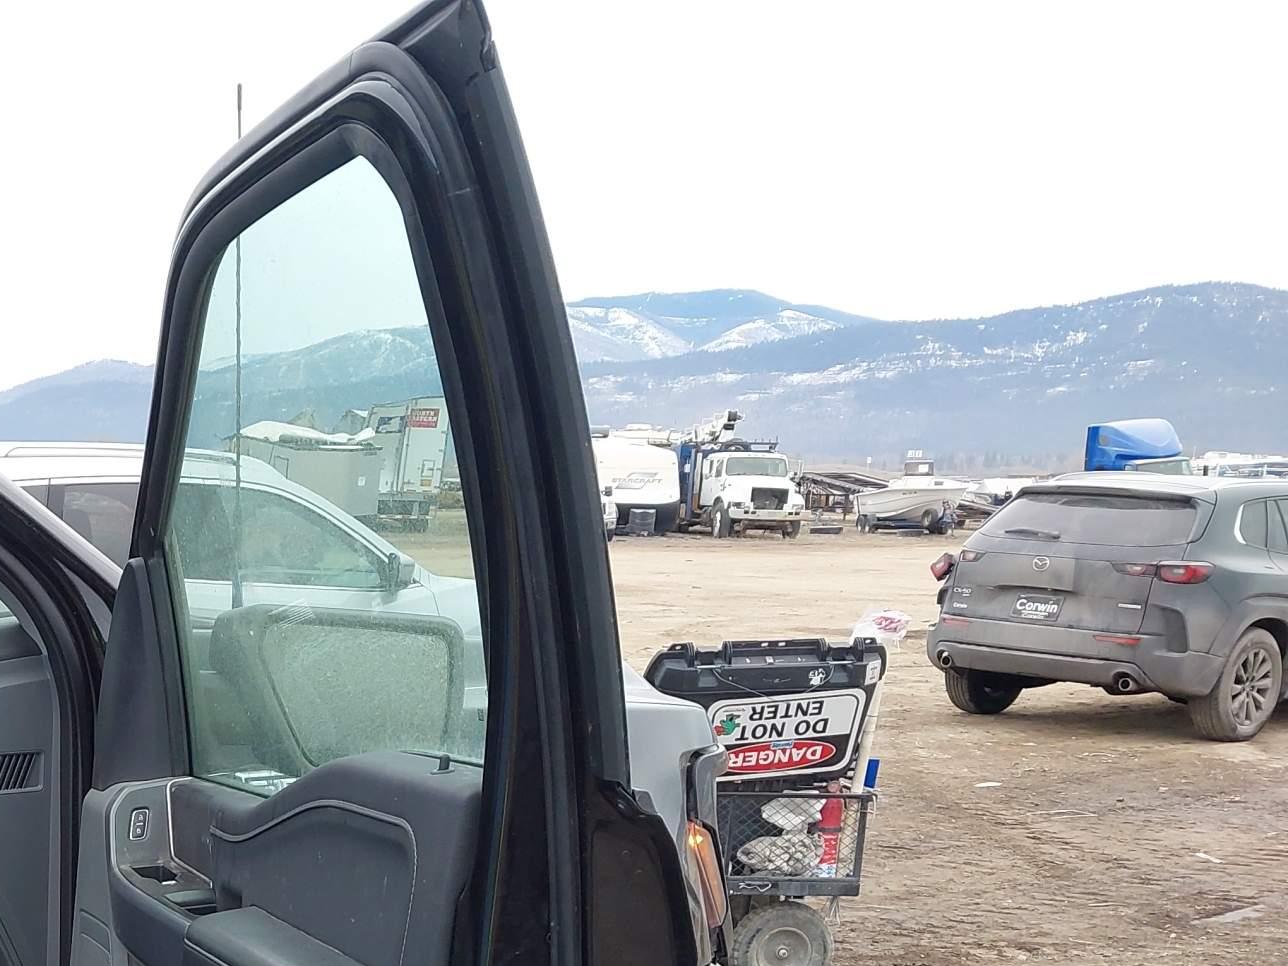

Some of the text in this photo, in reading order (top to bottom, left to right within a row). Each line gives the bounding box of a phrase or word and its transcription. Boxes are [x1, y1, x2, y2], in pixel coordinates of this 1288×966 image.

[1016, 599, 1058, 613] Corwin
[749, 700, 824, 721] ENTER
[735, 718, 829, 741] DO NOT
[728, 746, 822, 767] DANGER
